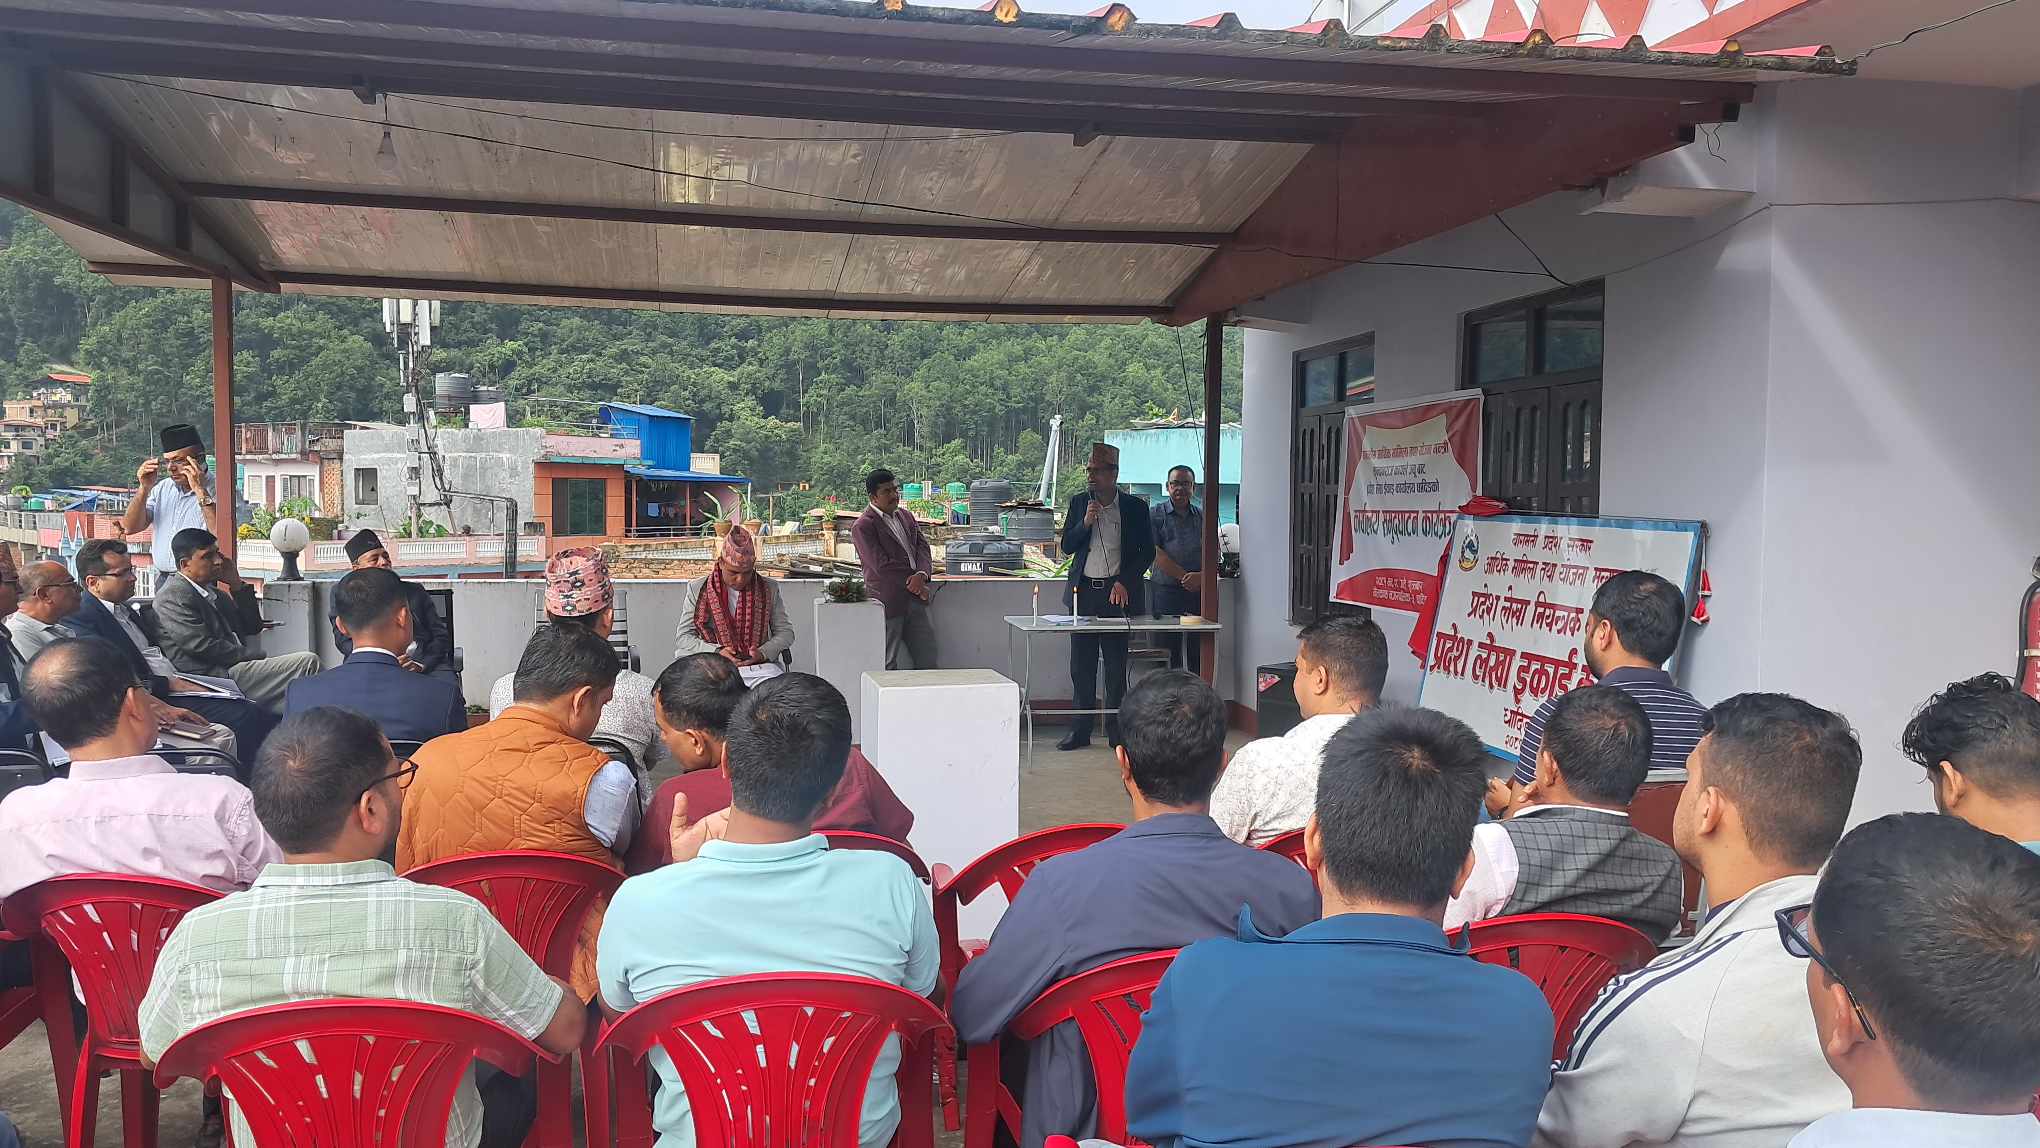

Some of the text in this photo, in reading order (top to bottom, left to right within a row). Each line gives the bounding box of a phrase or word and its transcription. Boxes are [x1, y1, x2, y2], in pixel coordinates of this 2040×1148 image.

[1421, 501, 1457, 541] कार्यक्र
[1543, 530, 1563, 552] प्रदेश
[1483, 551, 1510, 577] आर्थिक
[1511, 554, 1539, 582] मामिला
[1540, 562, 1557, 584] तथा
[1558, 558, 1589, 587] योजना
[1467, 583, 1584, 637] प्रदेश लेखा नियन्त्रक
[1429, 622, 1474, 679] प्रदेश
[1472, 631, 1517, 692] लेखा
[1513, 647, 1579, 704] इकाई
[1504, 734, 1522, 750] २०८
